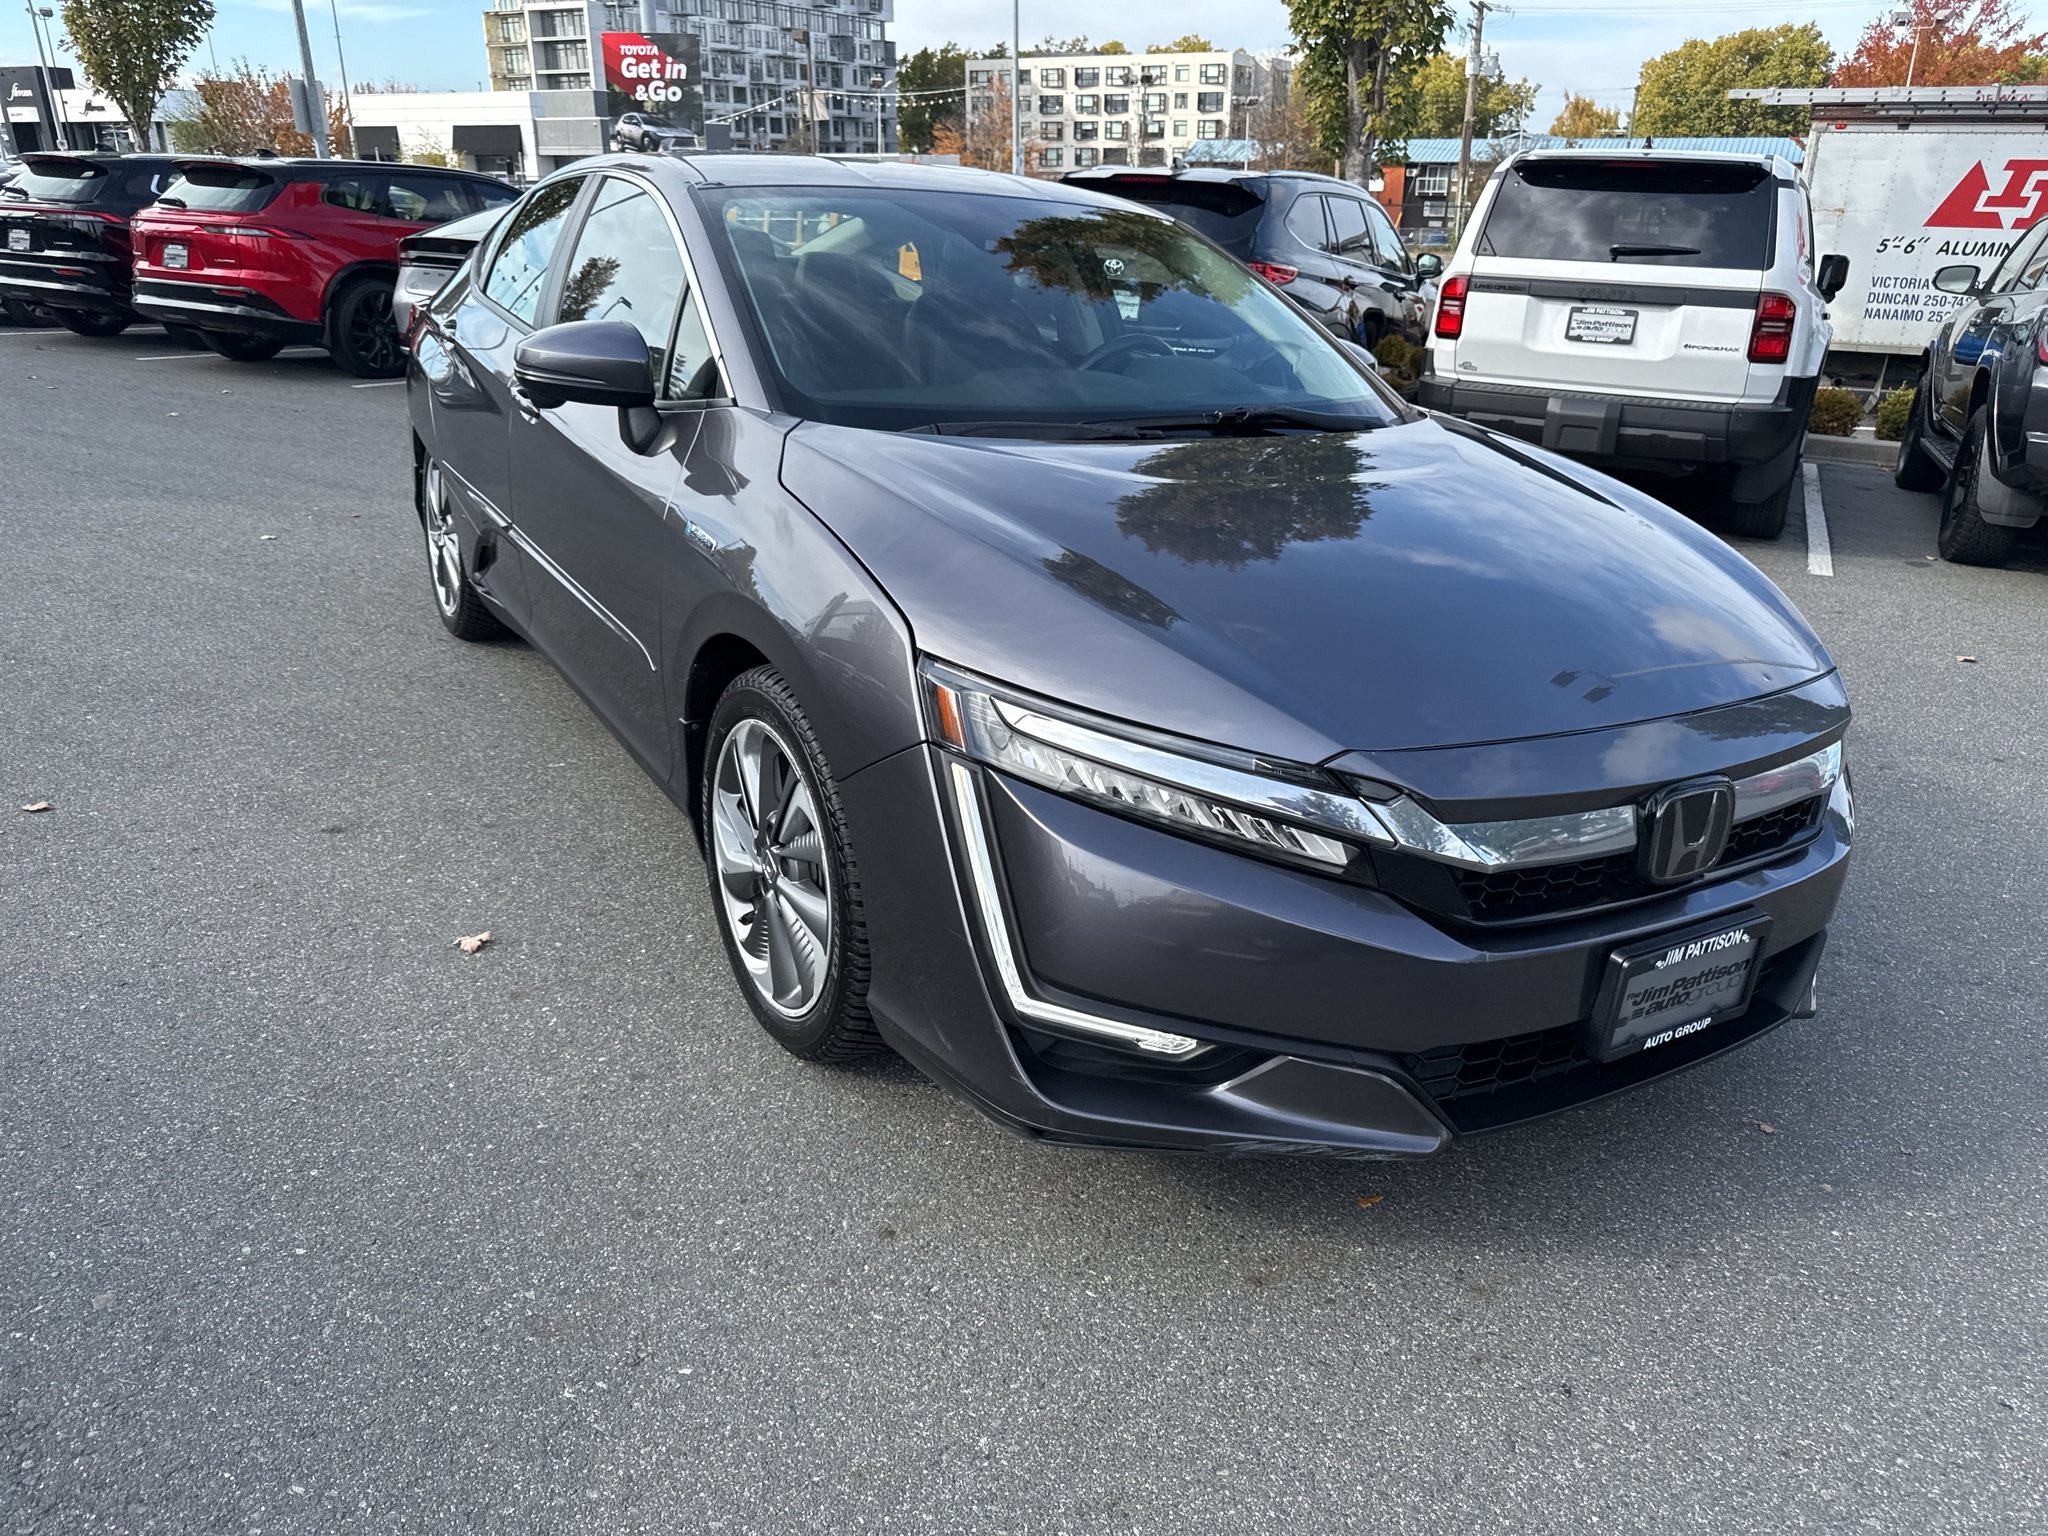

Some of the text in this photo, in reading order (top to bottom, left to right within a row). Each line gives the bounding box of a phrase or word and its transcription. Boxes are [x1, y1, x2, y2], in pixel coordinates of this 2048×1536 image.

[620, 45, 659, 55] TOYOTA
[621, 56, 688, 79] Get in
[635, 80, 682, 102] &Go
[1871, 276, 1930, 290] VICTORIA
[1867, 292, 1920, 305] DUNCAN
[1864, 308, 1924, 322] NANAIMO
[1663, 929, 1744, 968] JIM PATTISON
[1632, 985, 1671, 1007] Jim
[1668, 958, 1751, 997] Pattison
[1643, 1017, 1712, 1050] AUTO GROUP
